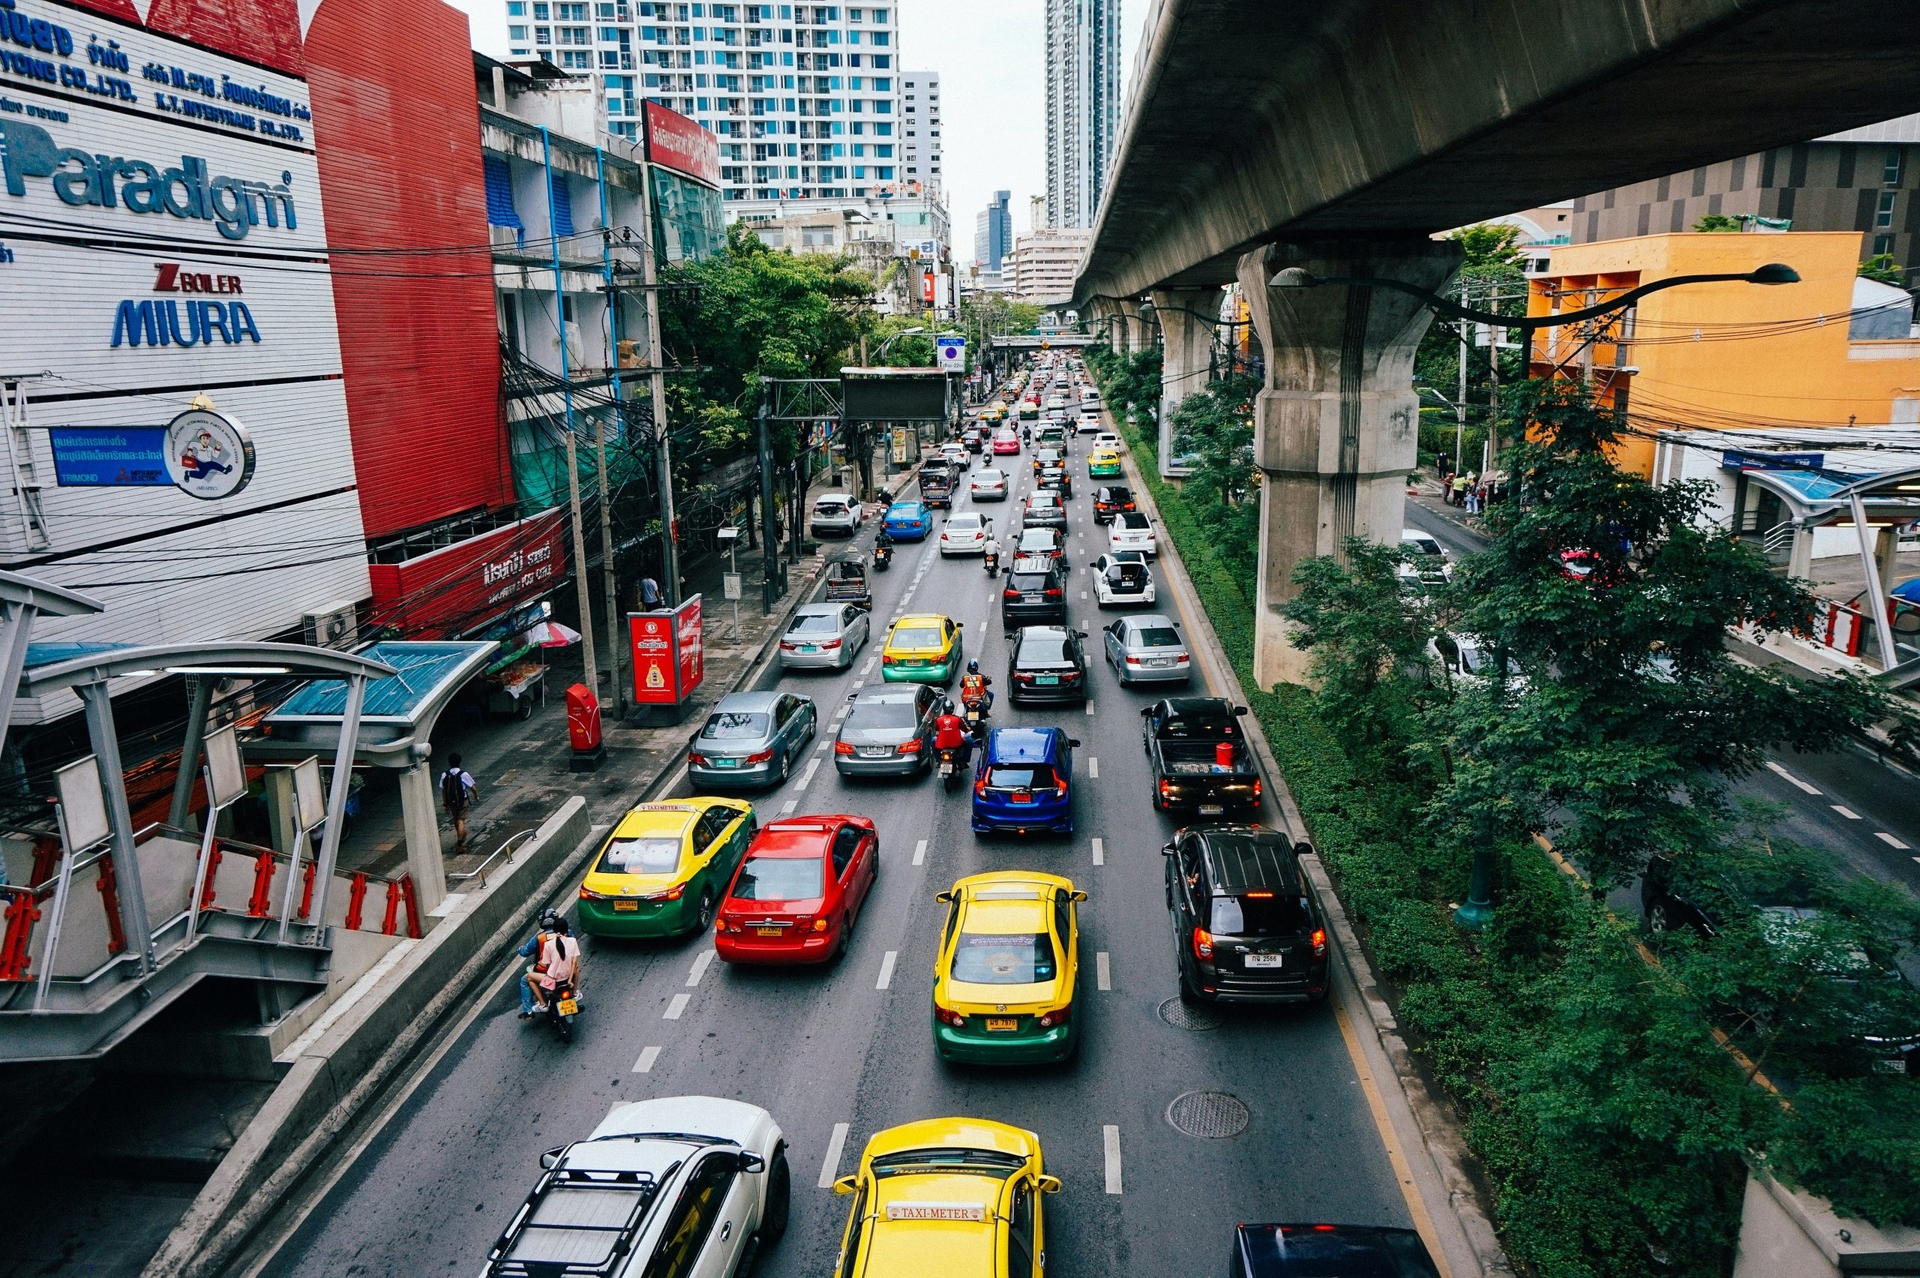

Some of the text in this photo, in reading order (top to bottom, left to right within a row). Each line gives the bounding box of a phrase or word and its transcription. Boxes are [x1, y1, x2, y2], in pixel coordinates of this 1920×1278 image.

[86, 33, 130, 73] จำกัด
[110, 299, 262, 348] MIURA
[61, 473, 99, 482] TRIMOND
[901, 1207, 969, 1219] TAXI-METER
